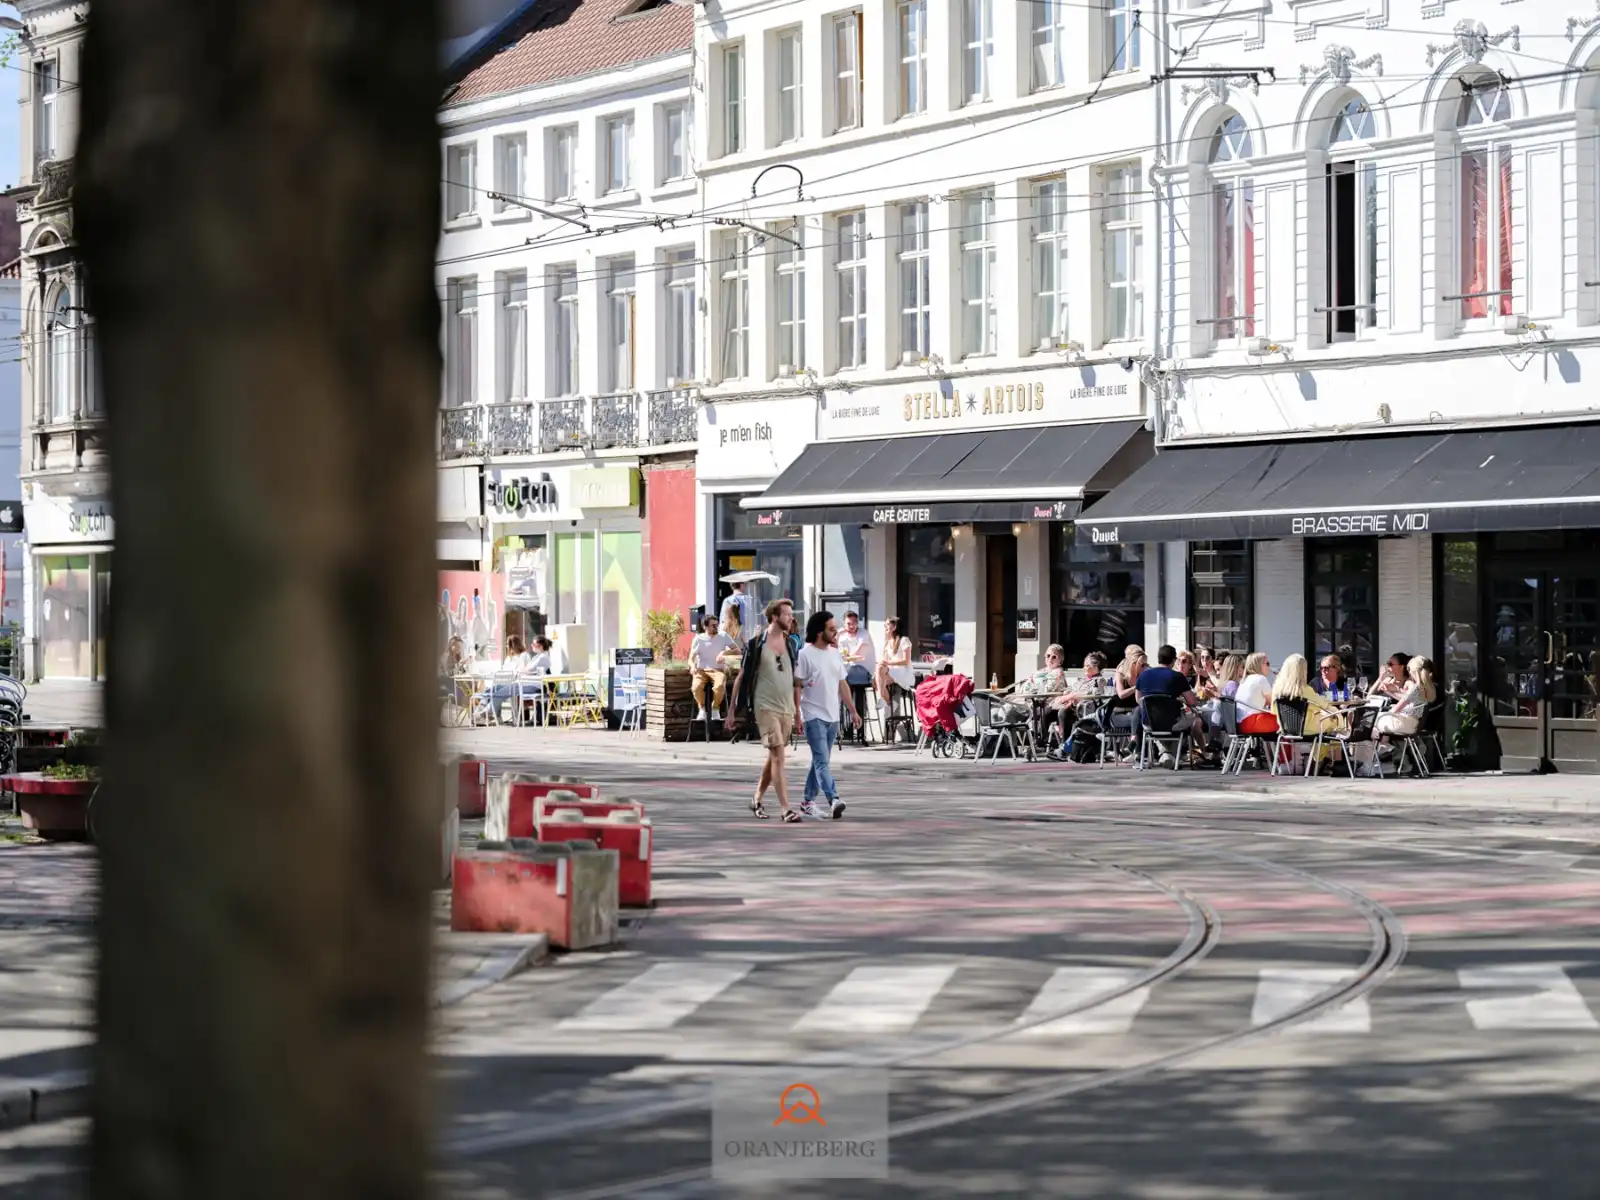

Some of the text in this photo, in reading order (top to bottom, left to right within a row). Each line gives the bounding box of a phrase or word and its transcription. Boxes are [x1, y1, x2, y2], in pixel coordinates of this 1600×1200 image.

[903, 381, 1044, 421] STELLA ARTOIS
[719, 421, 772, 447] je m'en fish
[873, 506, 930, 523] CAFÉ CENTER
[1033, 506, 1053, 518] Duvel
[1291, 512, 1430, 534] BRASSERIE MIDI
[1092, 526, 1119, 543] Duvel
